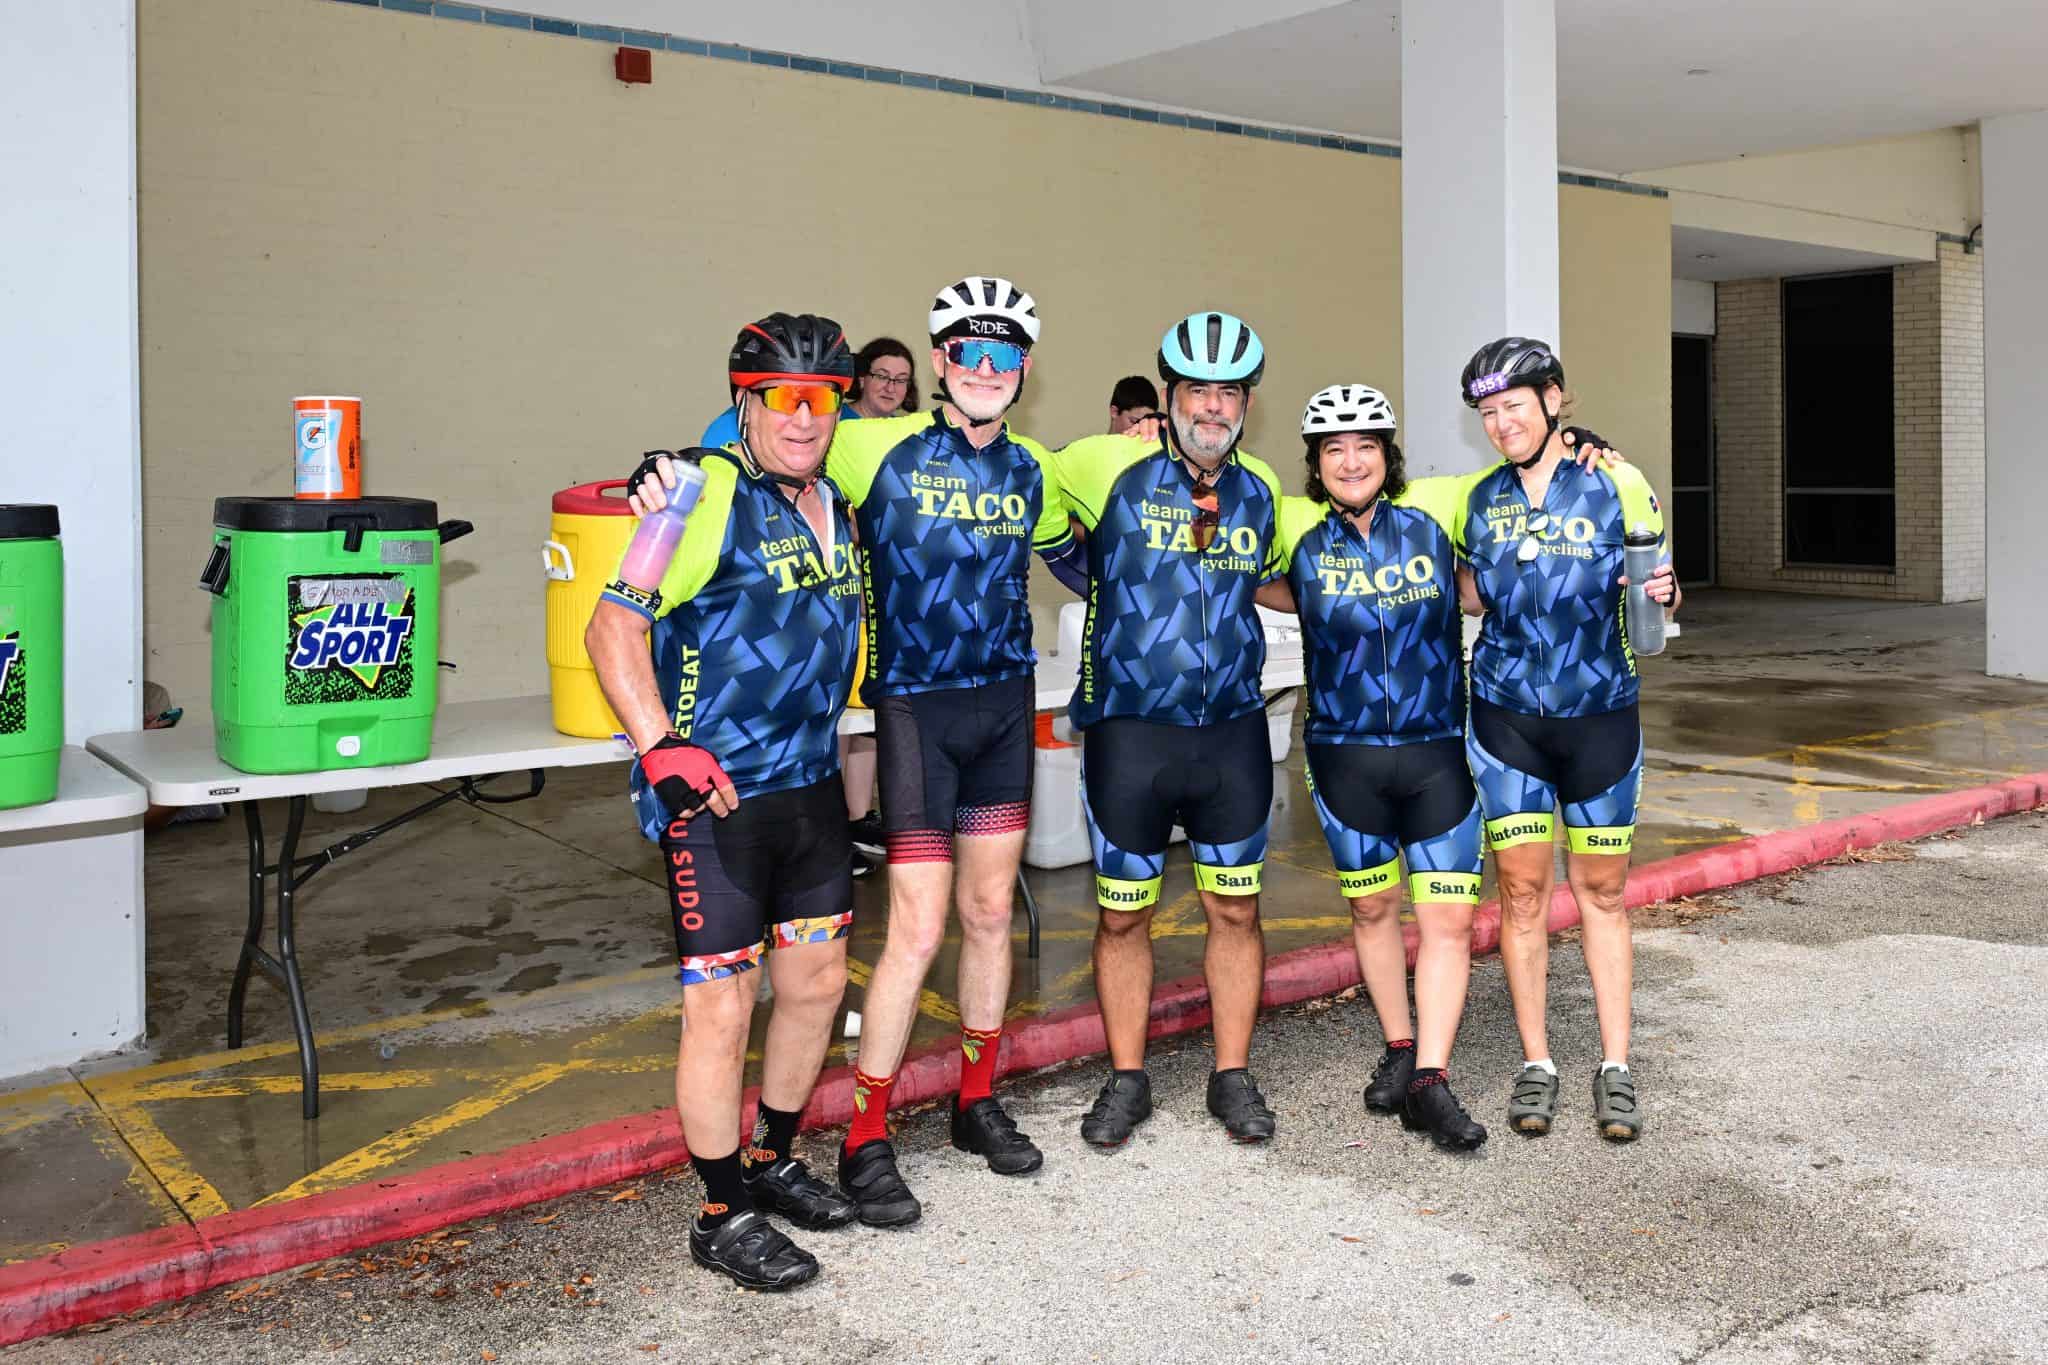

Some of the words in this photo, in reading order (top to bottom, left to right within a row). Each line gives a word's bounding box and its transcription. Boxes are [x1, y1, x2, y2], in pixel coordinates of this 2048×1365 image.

[968, 319, 1011, 335] RIDE
[911, 469, 967, 490] team
[911, 487, 1026, 521] TACO
[1141, 498, 1191, 521] team
[1487, 503, 1526, 519] team
[973, 521, 1025, 538] cycling
[1140, 517, 1257, 555] TACO
[760, 535, 811, 559] team
[1200, 556, 1257, 575] cycling
[1319, 551, 1363, 569] team
[1317, 555, 1434, 596] TACO
[1377, 583, 1440, 610] cycling
[327, 601, 391, 629] ALL
[293, 618, 410, 667] SPORT
[1587, 834, 1621, 848] San
[672, 849, 705, 931] SUDO
[1216, 873, 1252, 887] San
[1430, 881, 1465, 895] San
